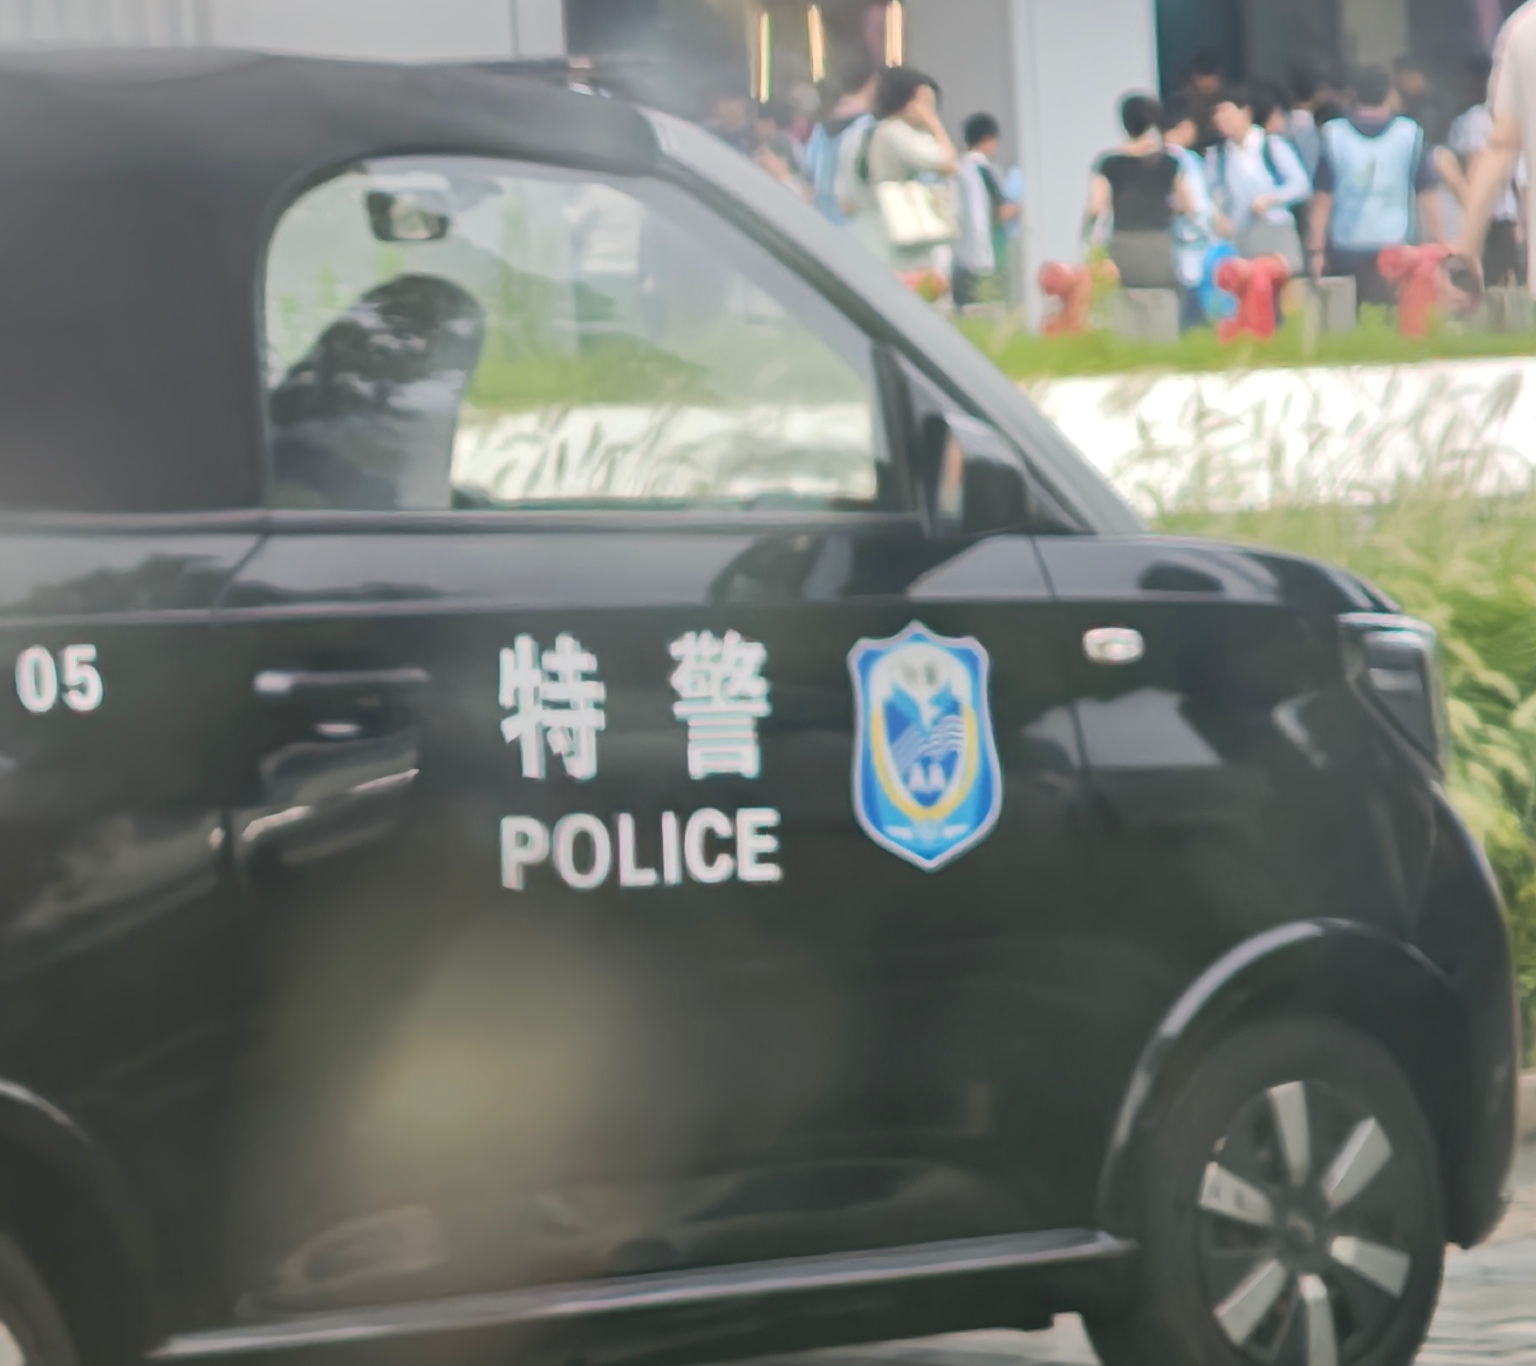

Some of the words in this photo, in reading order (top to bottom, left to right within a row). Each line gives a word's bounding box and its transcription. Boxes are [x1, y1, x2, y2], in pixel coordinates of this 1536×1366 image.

[15, 643, 103, 714] 05
[498, 629, 773, 782] 特警
[500, 806, 783, 891] POLICE
